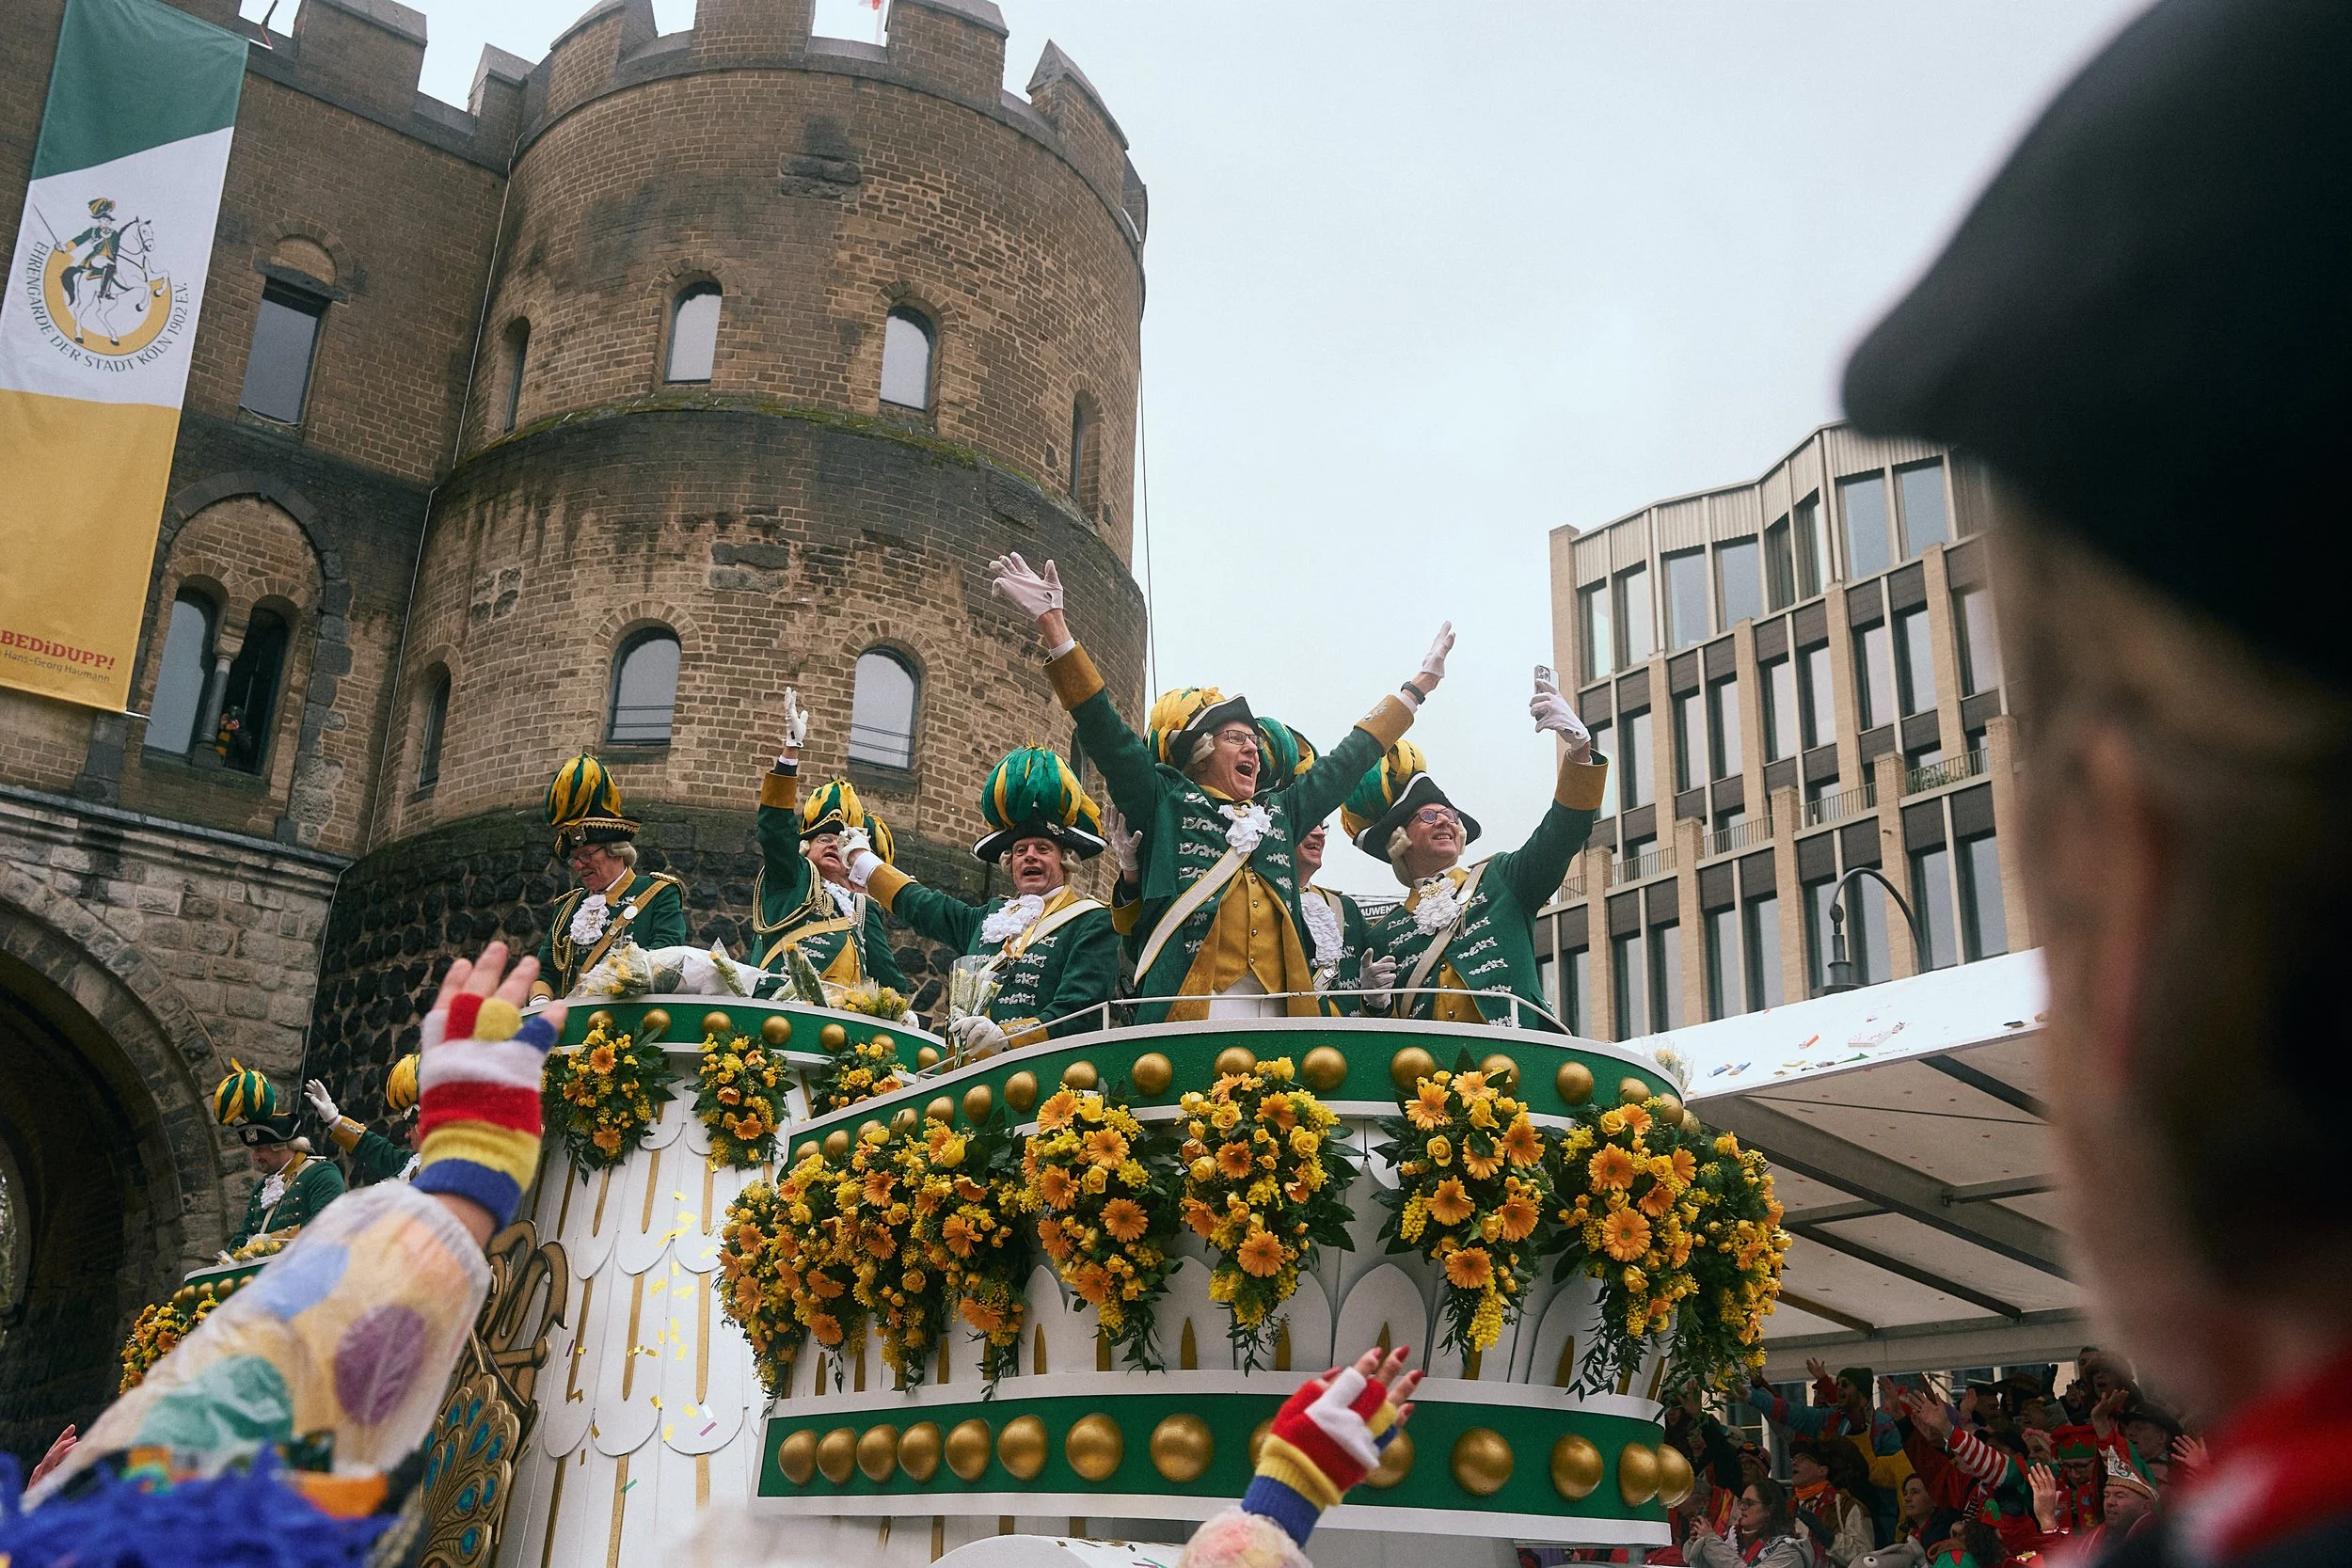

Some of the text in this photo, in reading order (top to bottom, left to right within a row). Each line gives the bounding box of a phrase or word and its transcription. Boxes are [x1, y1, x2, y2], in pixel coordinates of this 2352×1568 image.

[25, 241, 189, 372] EHRENGARDE DER STADT KÖLN 1902 E.V.
[5, 650, 110, 683] Hans-Georg Haumann
